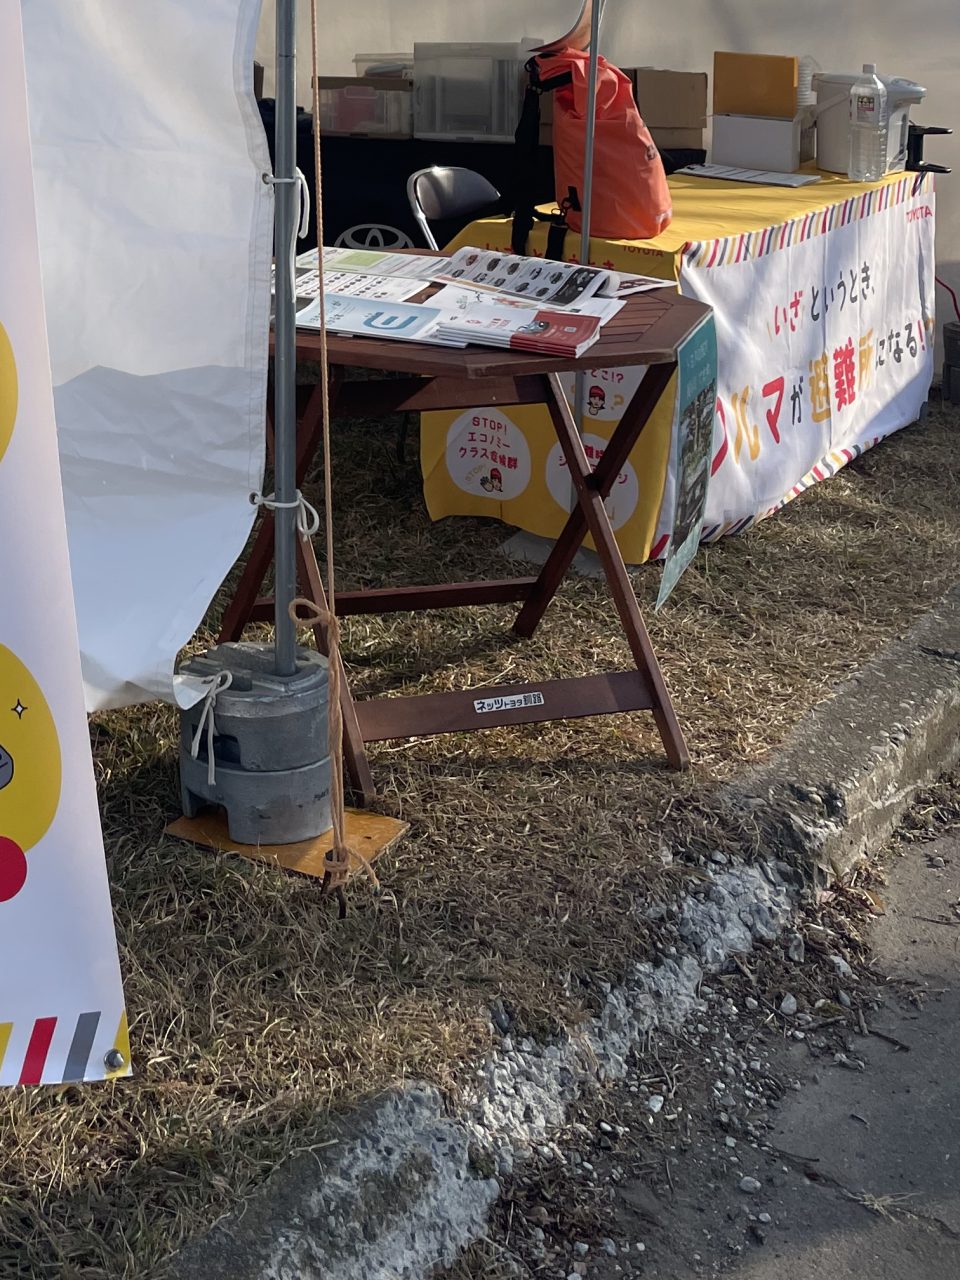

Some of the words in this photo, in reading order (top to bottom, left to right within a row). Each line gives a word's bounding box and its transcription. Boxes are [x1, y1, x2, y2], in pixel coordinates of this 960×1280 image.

[622, 245, 665, 258] TOYOTA
[467, 432, 510, 449] エコノミー
